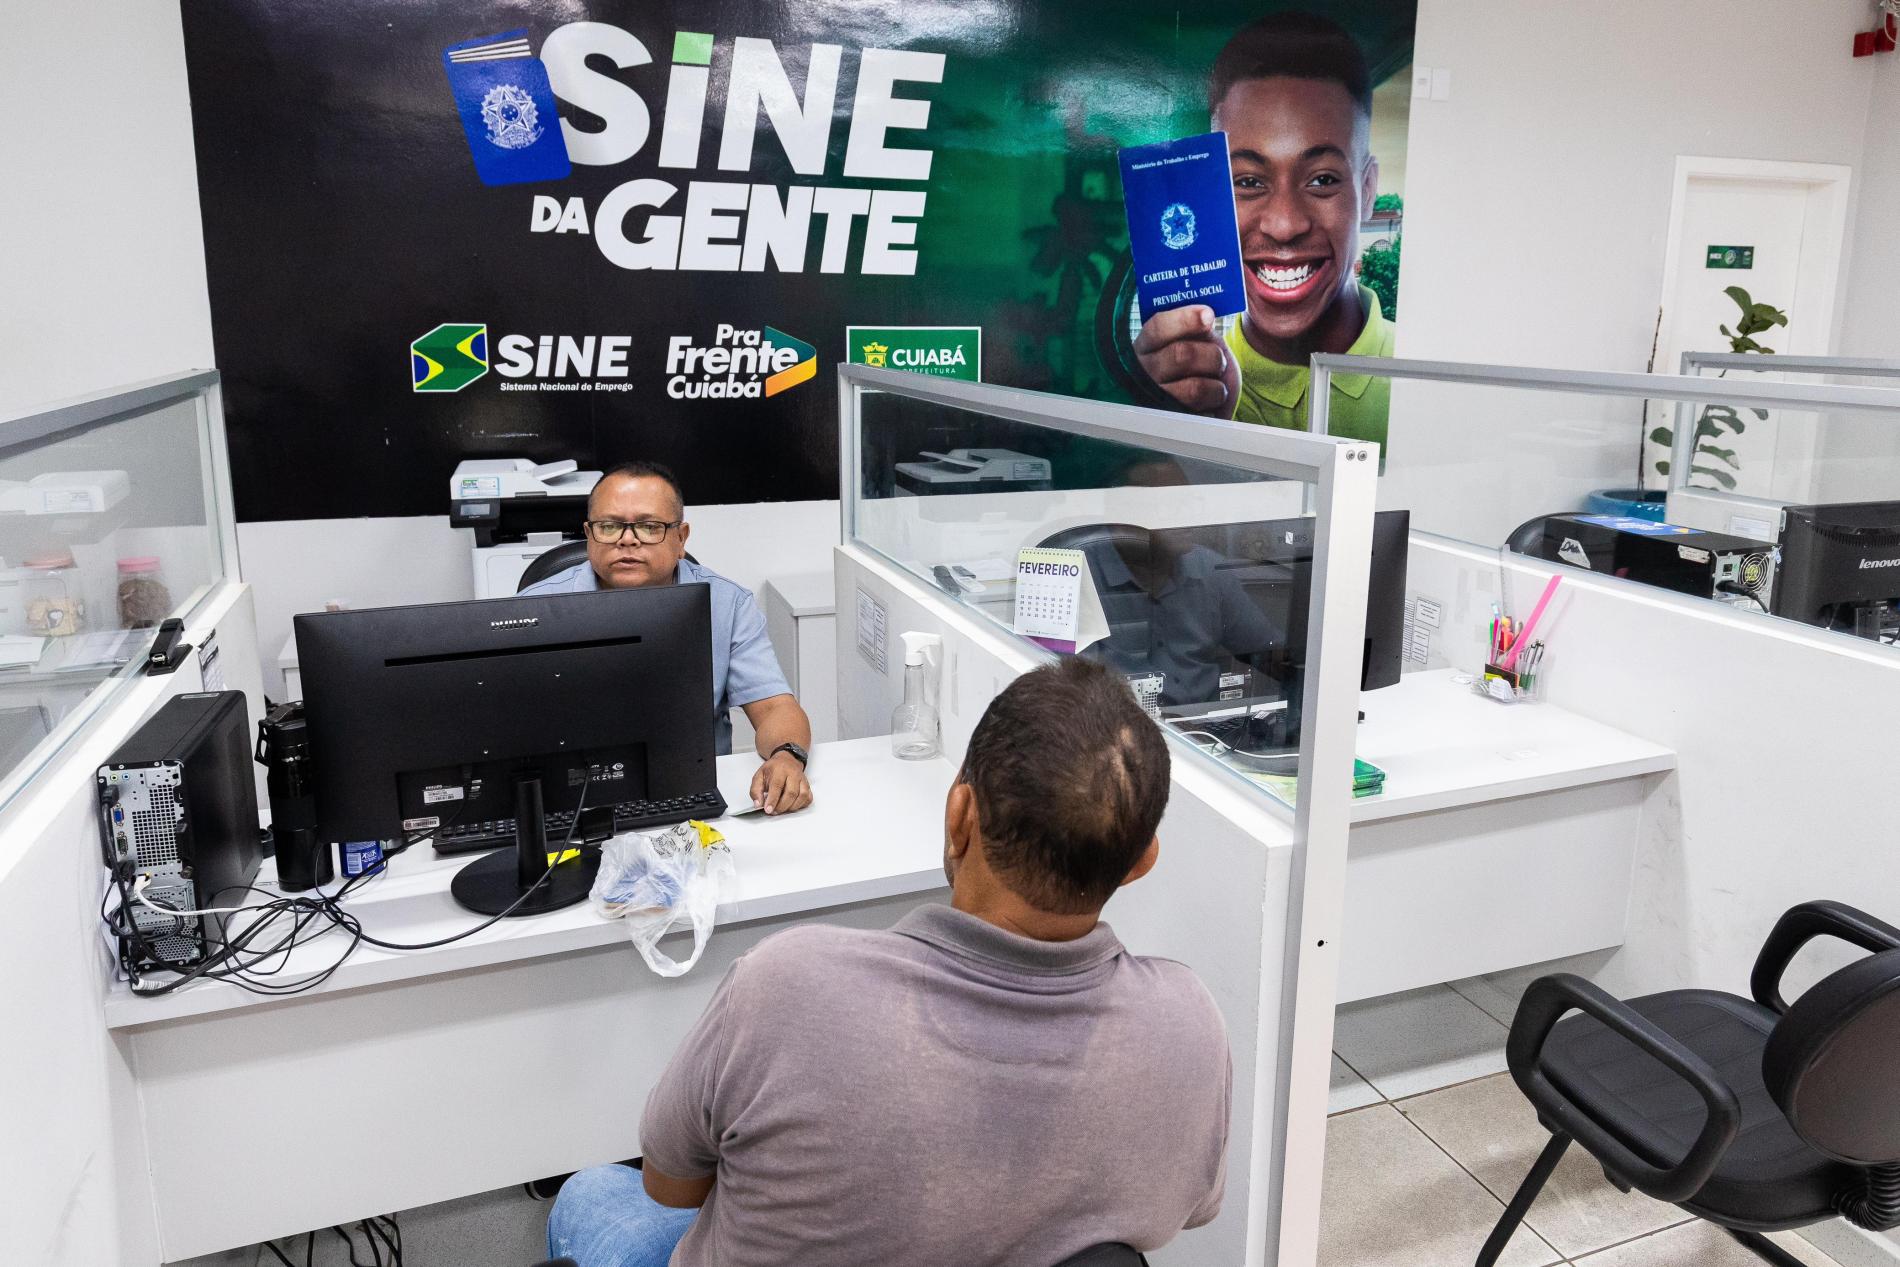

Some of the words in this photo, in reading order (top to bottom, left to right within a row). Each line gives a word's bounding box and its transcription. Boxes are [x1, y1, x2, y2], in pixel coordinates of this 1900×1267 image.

[531, 195, 590, 235] DA
[594, 178, 928, 276] GENTE
[1143, 269, 1179, 284] CARTEIRA
[1180, 266, 1190, 277] DE
[1191, 258, 1227, 275] TRABALHO
[1184, 278, 1190, 288] E
[1153, 290, 1199, 307] PREVIDÊNCIA
[1200, 283, 1225, 297] SOCIAL
[715, 323, 761, 347] Pra
[665, 336, 799, 375] Frente
[892, 345, 967, 366] CUIABÁ
[500, 382, 538, 391] Sistema
[540, 382, 580, 391] Nacional
[581, 382, 593, 391] de
[595, 382, 634, 392] Emprego
[666, 374, 762, 400] Cuiabá
[1018, 561, 1079, 577] FEVEREIRO
[1859, 558, 1900, 569] lenovo
